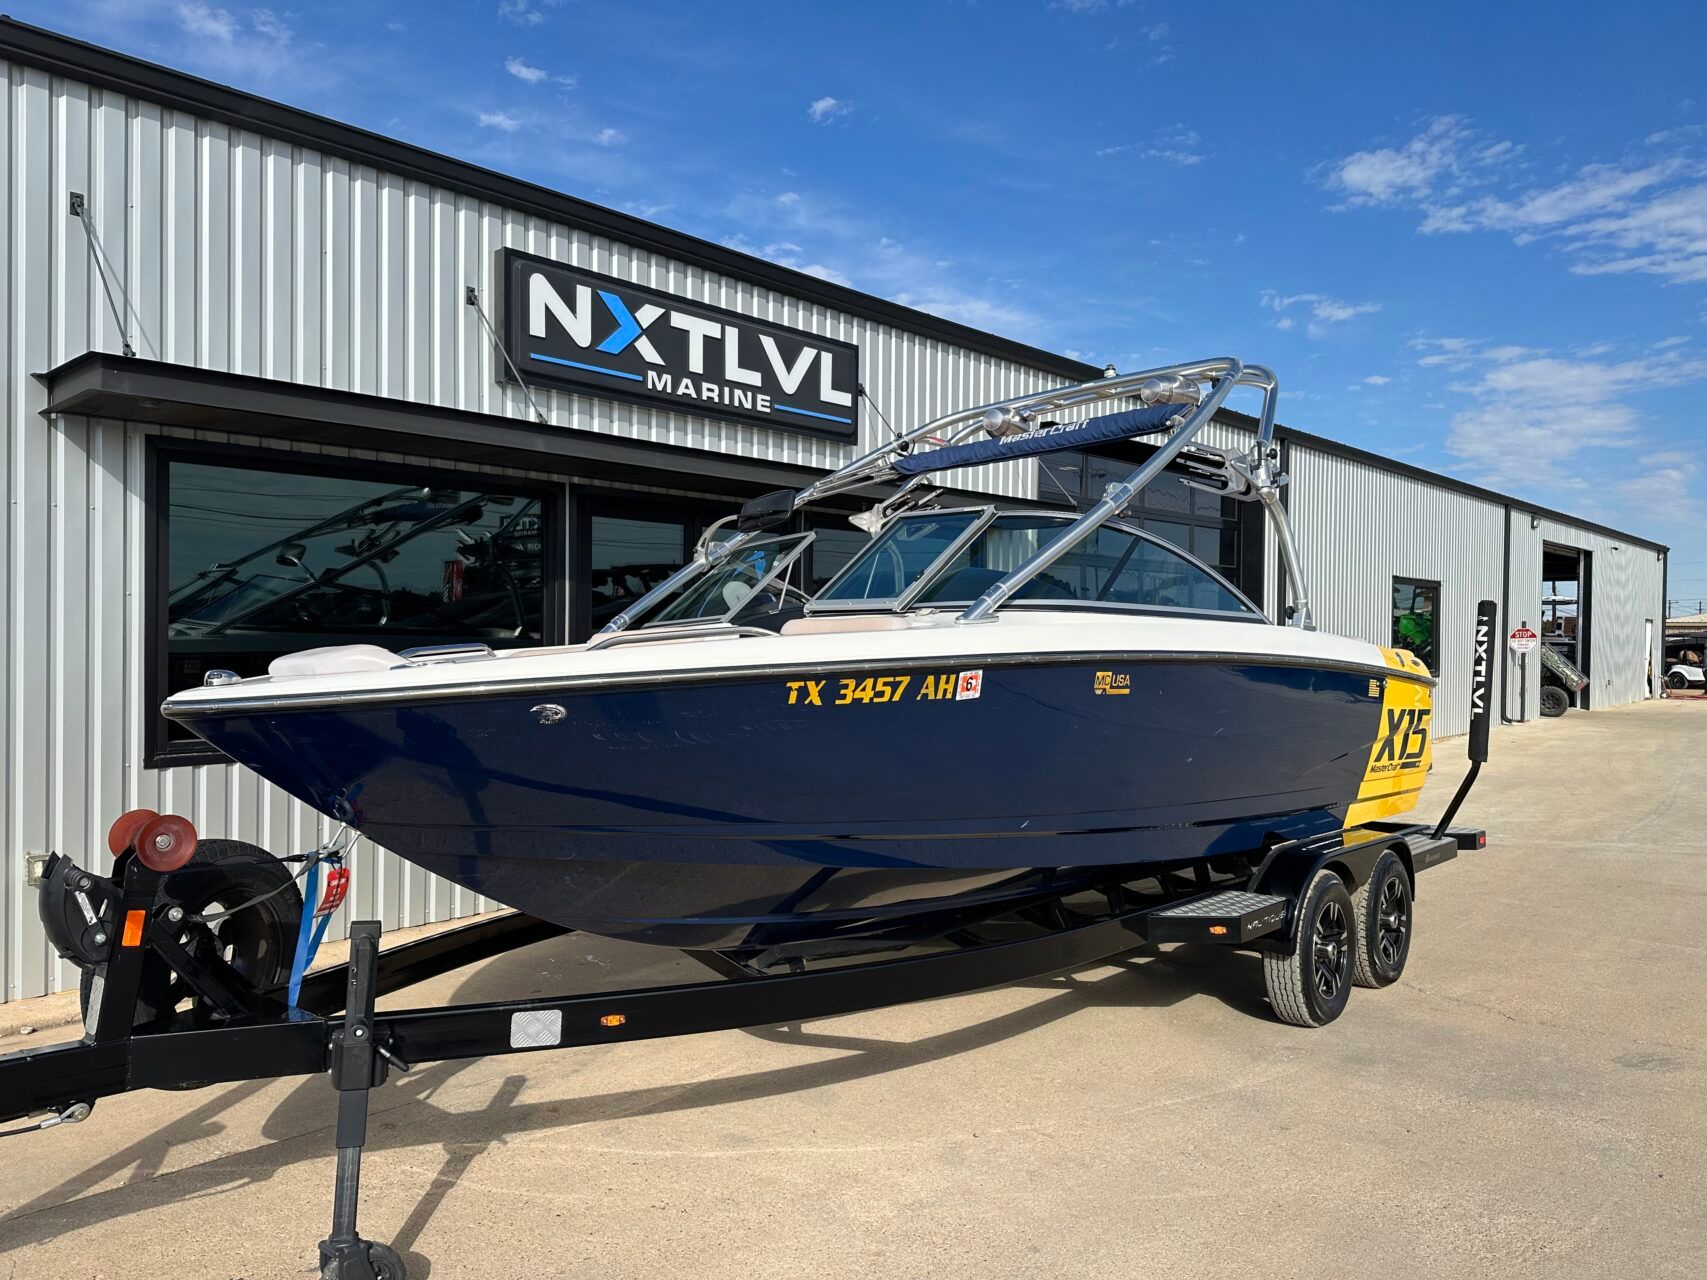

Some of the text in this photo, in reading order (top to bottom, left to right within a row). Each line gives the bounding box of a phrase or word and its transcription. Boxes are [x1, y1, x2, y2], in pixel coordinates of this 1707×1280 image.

[529, 272, 852, 408] NXTLVL
[647, 370, 771, 413] MARINE
[786, 674, 956, 706] TX 3457 AH
[1112, 674, 1130, 686] USA
[1471, 625, 1489, 720] NXTLVL
[1374, 708, 1431, 762] X15
